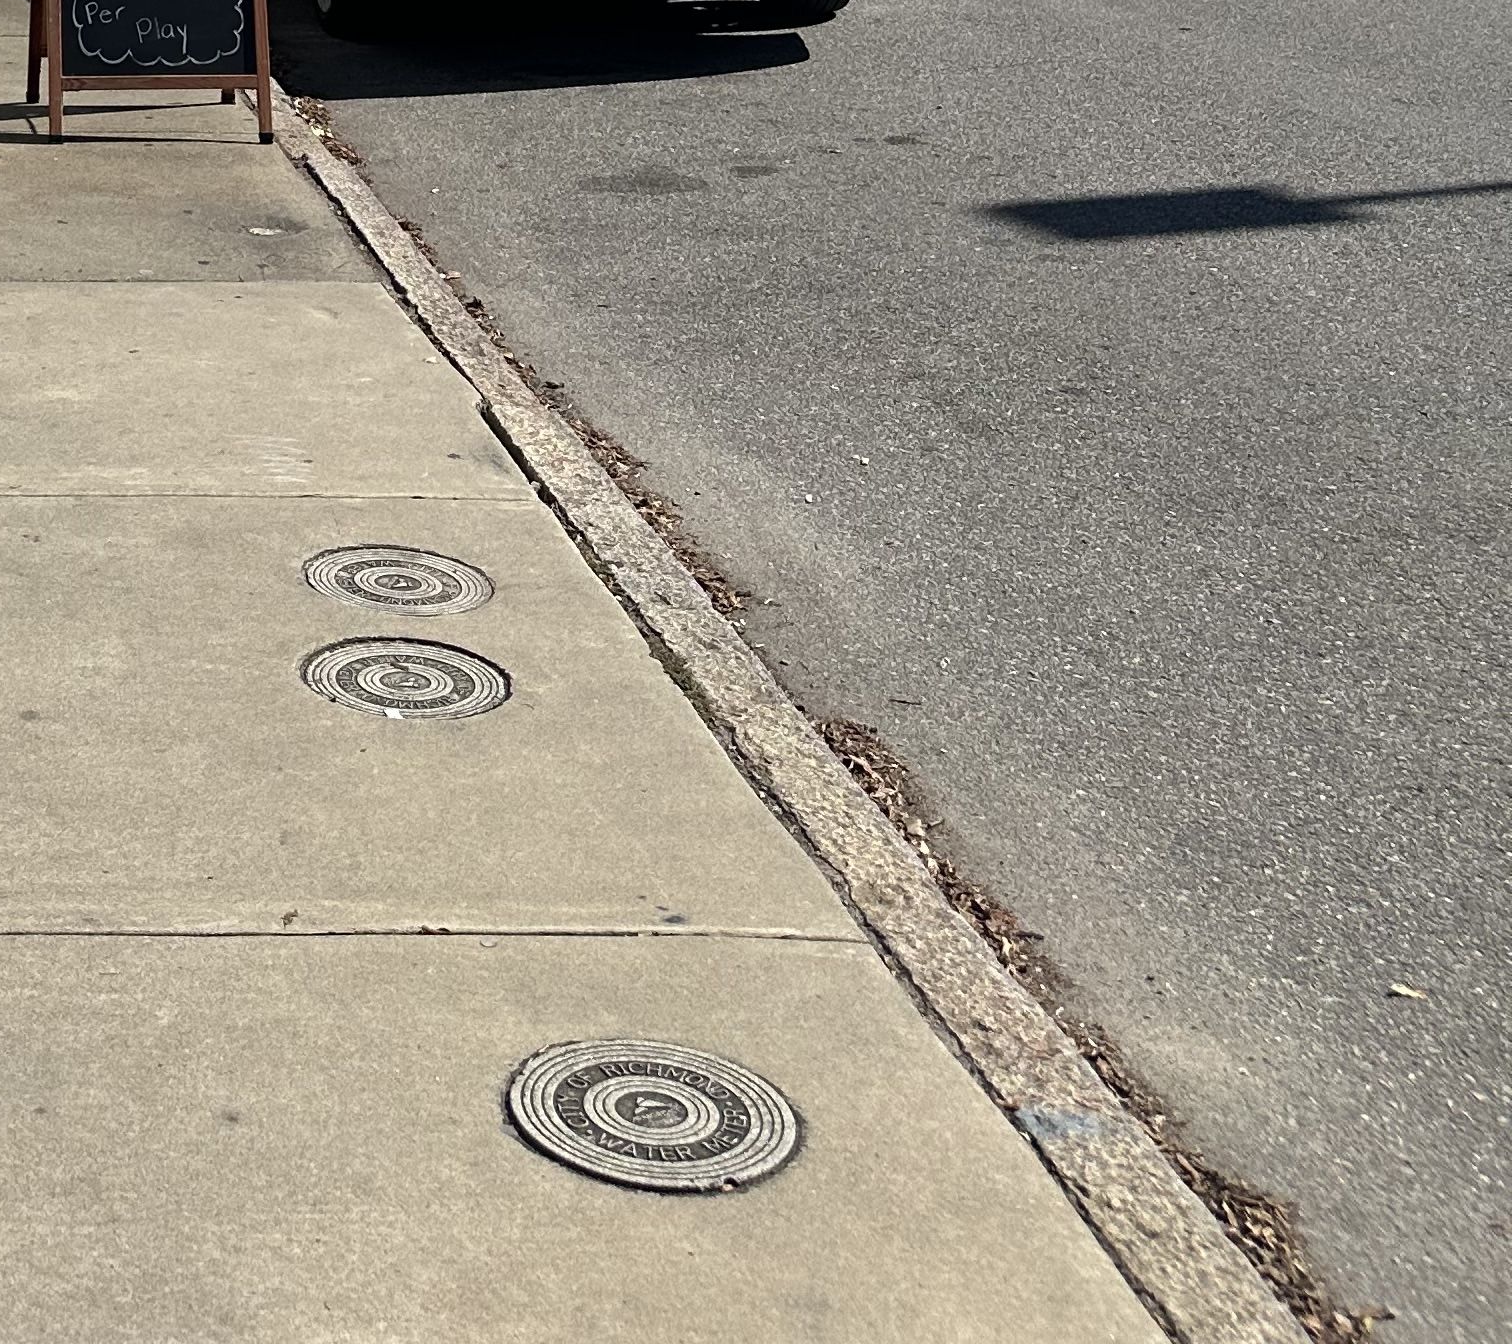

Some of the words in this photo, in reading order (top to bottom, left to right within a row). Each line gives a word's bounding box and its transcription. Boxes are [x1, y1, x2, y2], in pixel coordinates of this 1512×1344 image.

[84, 0, 125, 25] Per
[135, 16, 188, 54] Play
[567, 1071, 593, 1089] OF
[600, 1061, 730, 1101] RICHMOND
[555, 1092, 589, 1129] CITY
[597, 1131, 698, 1162] WATER
[702, 1106, 748, 1153] METER
